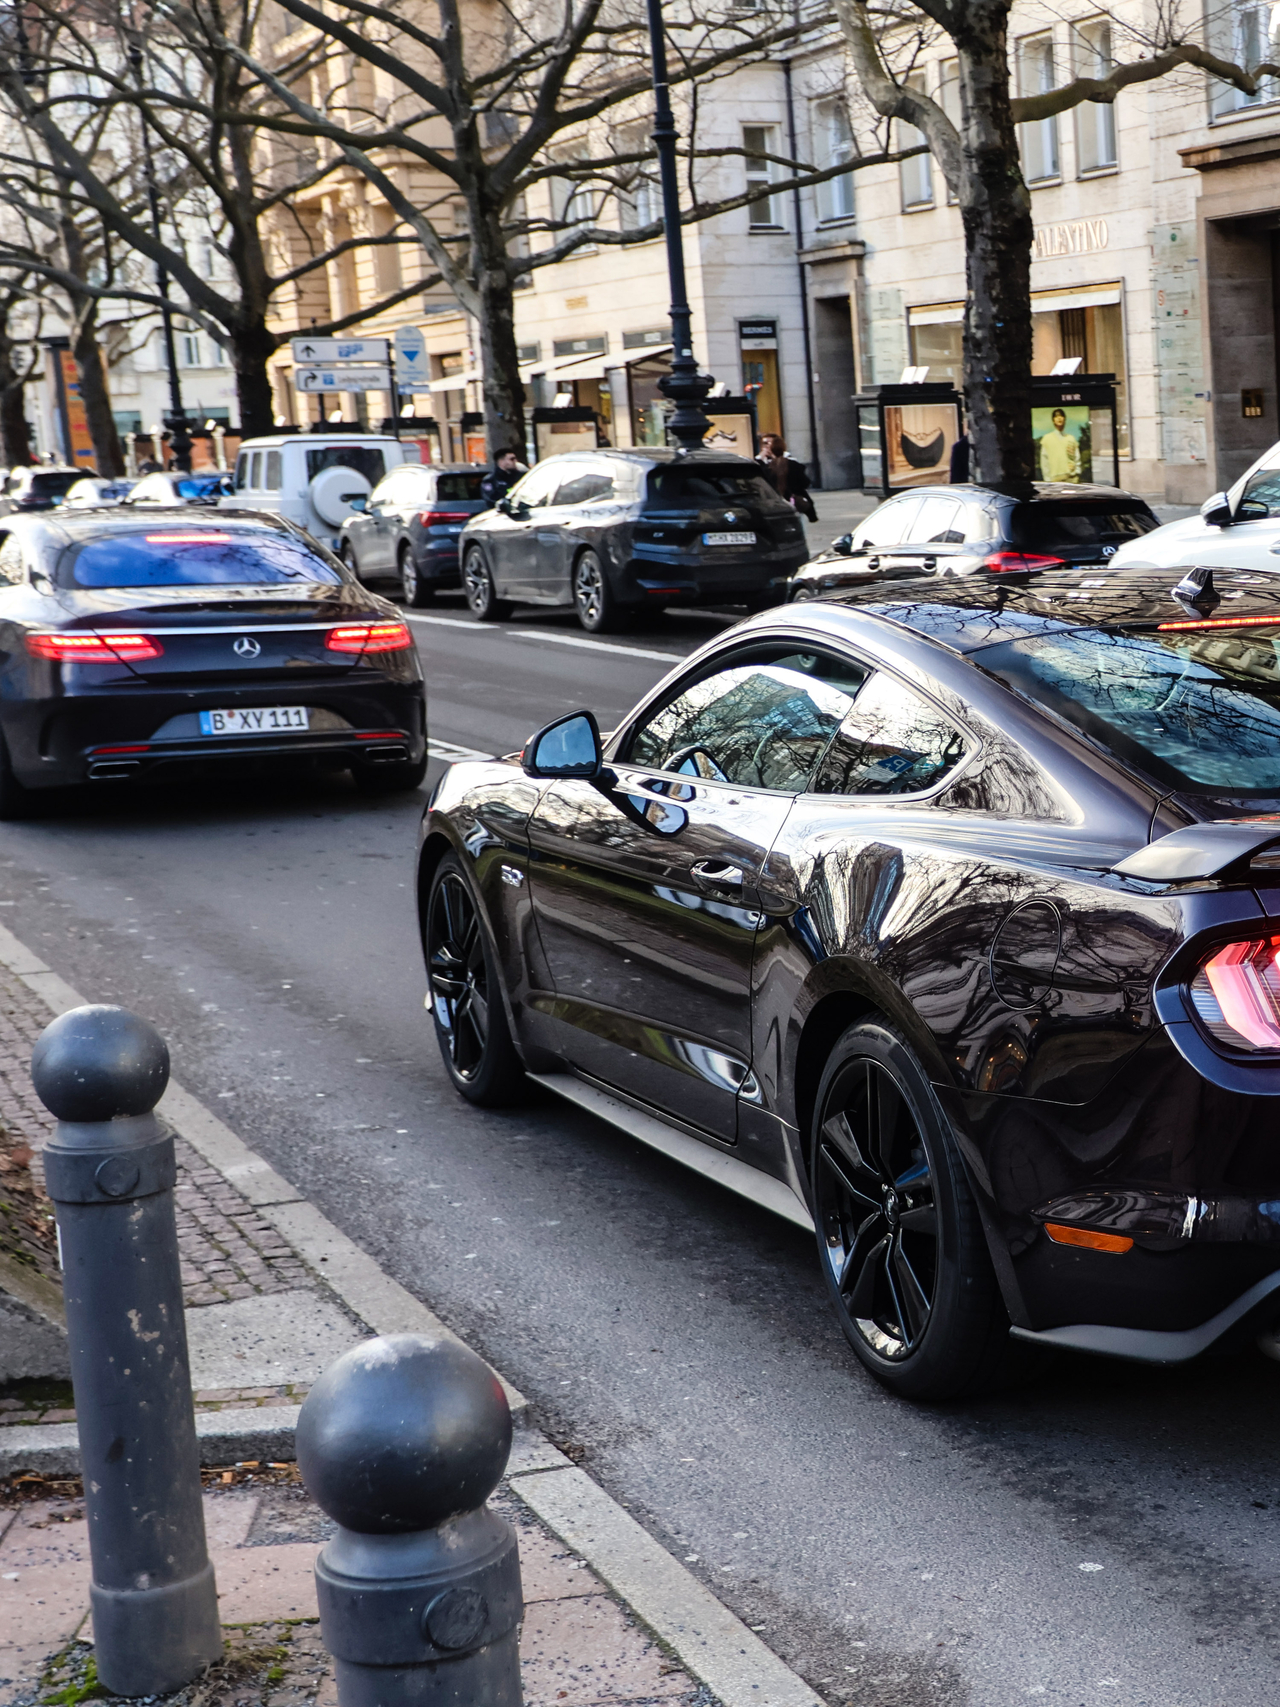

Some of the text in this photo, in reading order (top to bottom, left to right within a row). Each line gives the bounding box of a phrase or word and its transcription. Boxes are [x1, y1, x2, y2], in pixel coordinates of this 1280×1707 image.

[213, 709, 306, 731] B XY 111
